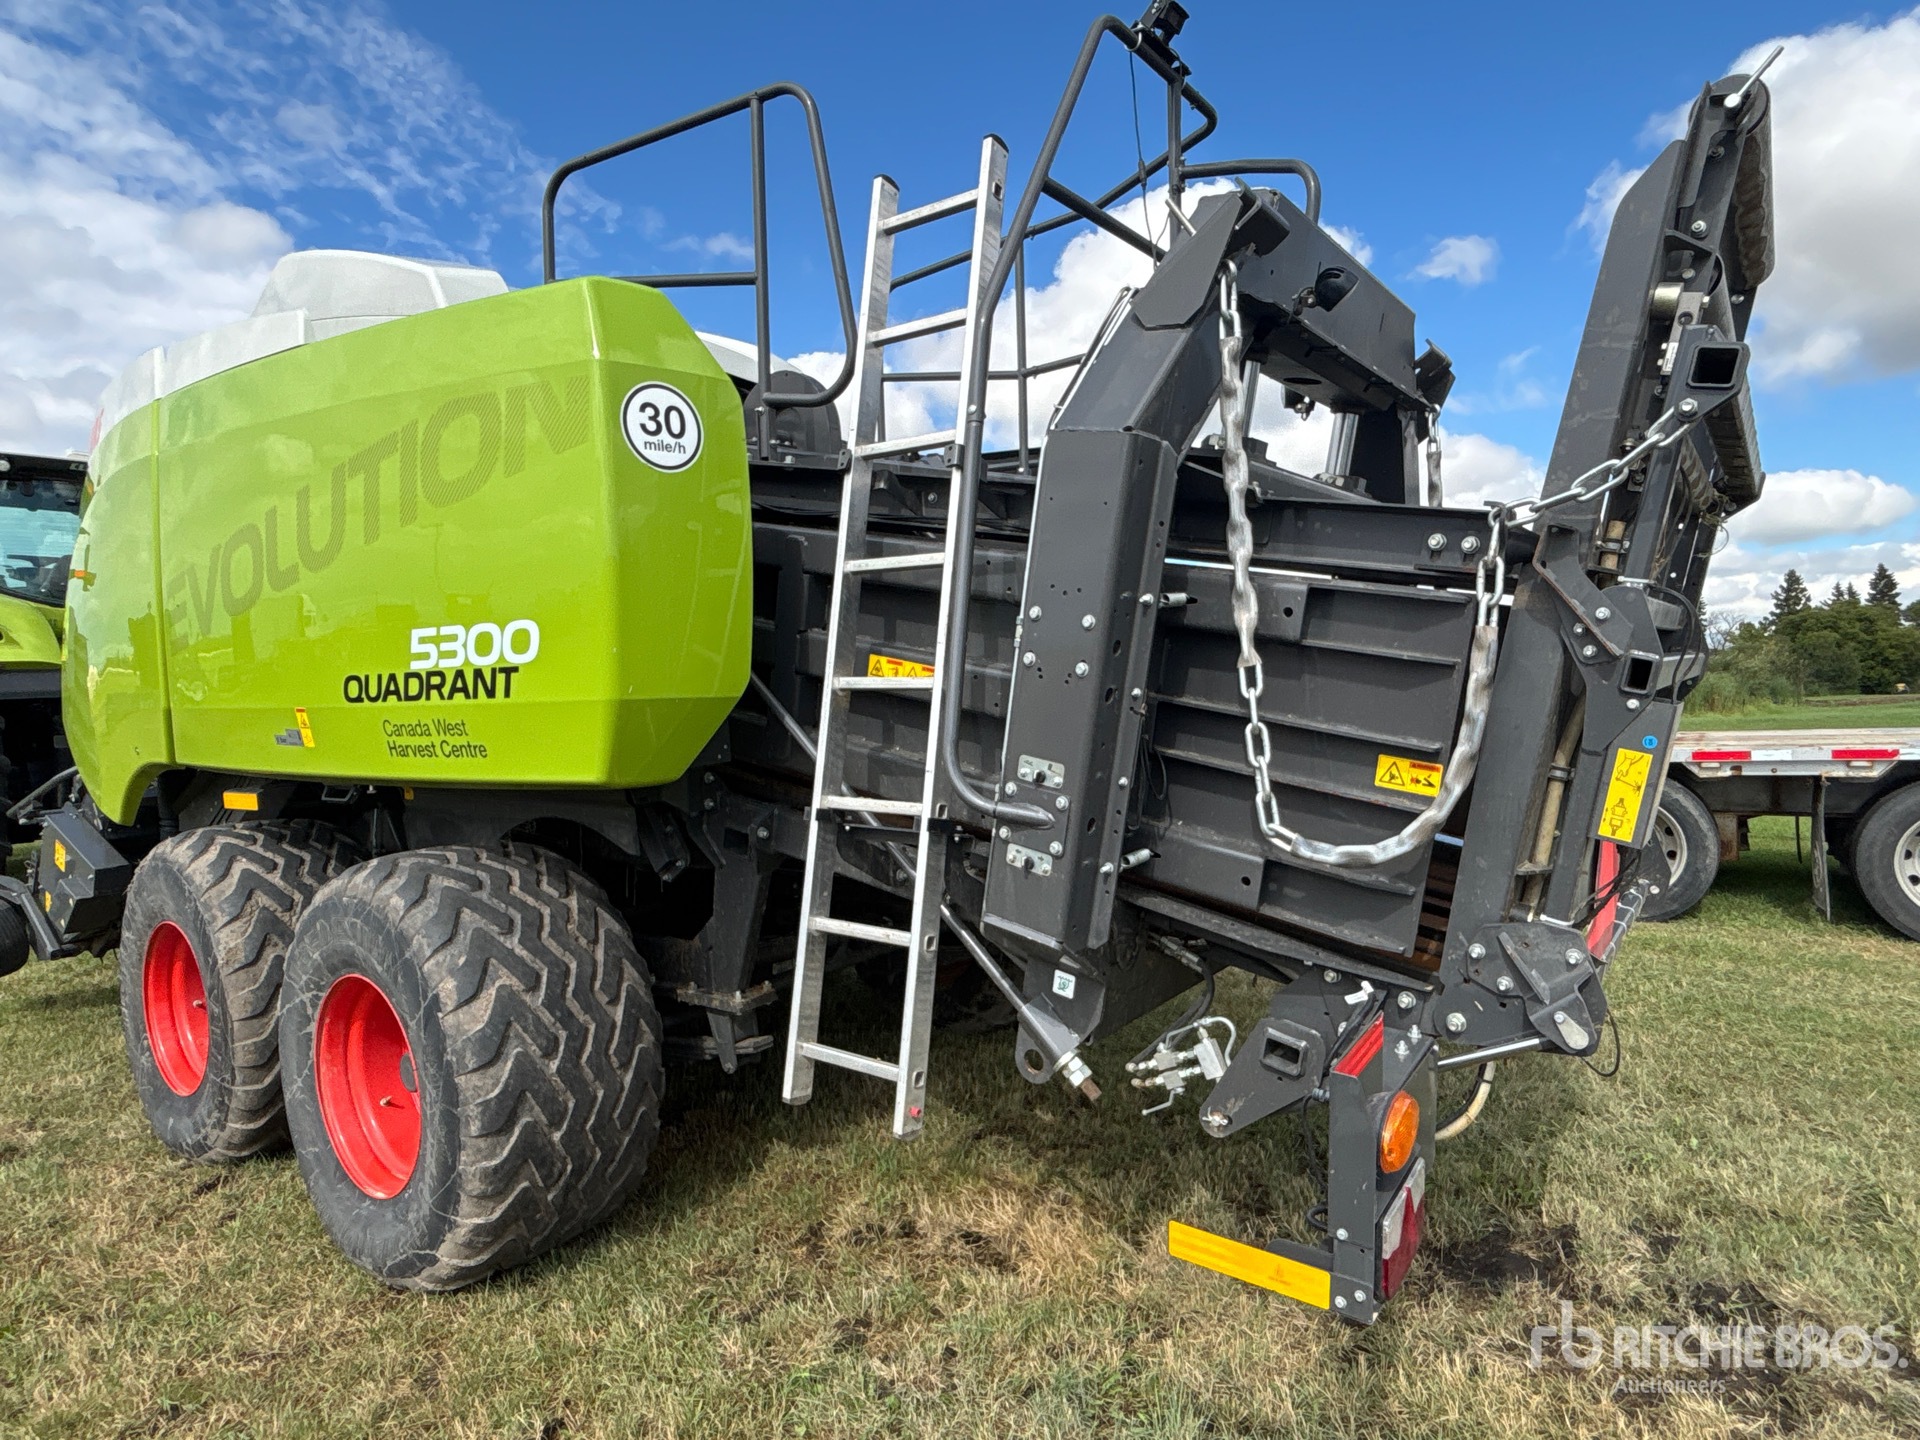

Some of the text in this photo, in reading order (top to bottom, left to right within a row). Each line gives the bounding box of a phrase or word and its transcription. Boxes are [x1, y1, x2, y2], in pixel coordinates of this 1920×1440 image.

[639, 402, 686, 439] 30
[644, 440, 686, 454] mile/h
[166, 375, 590, 657] EVOLUTION
[410, 619, 540, 669] 5300
[343, 666, 519, 703] QUADRANT
[383, 718, 468, 737] Canada West
[387, 740, 488, 758] Harvest Centre
